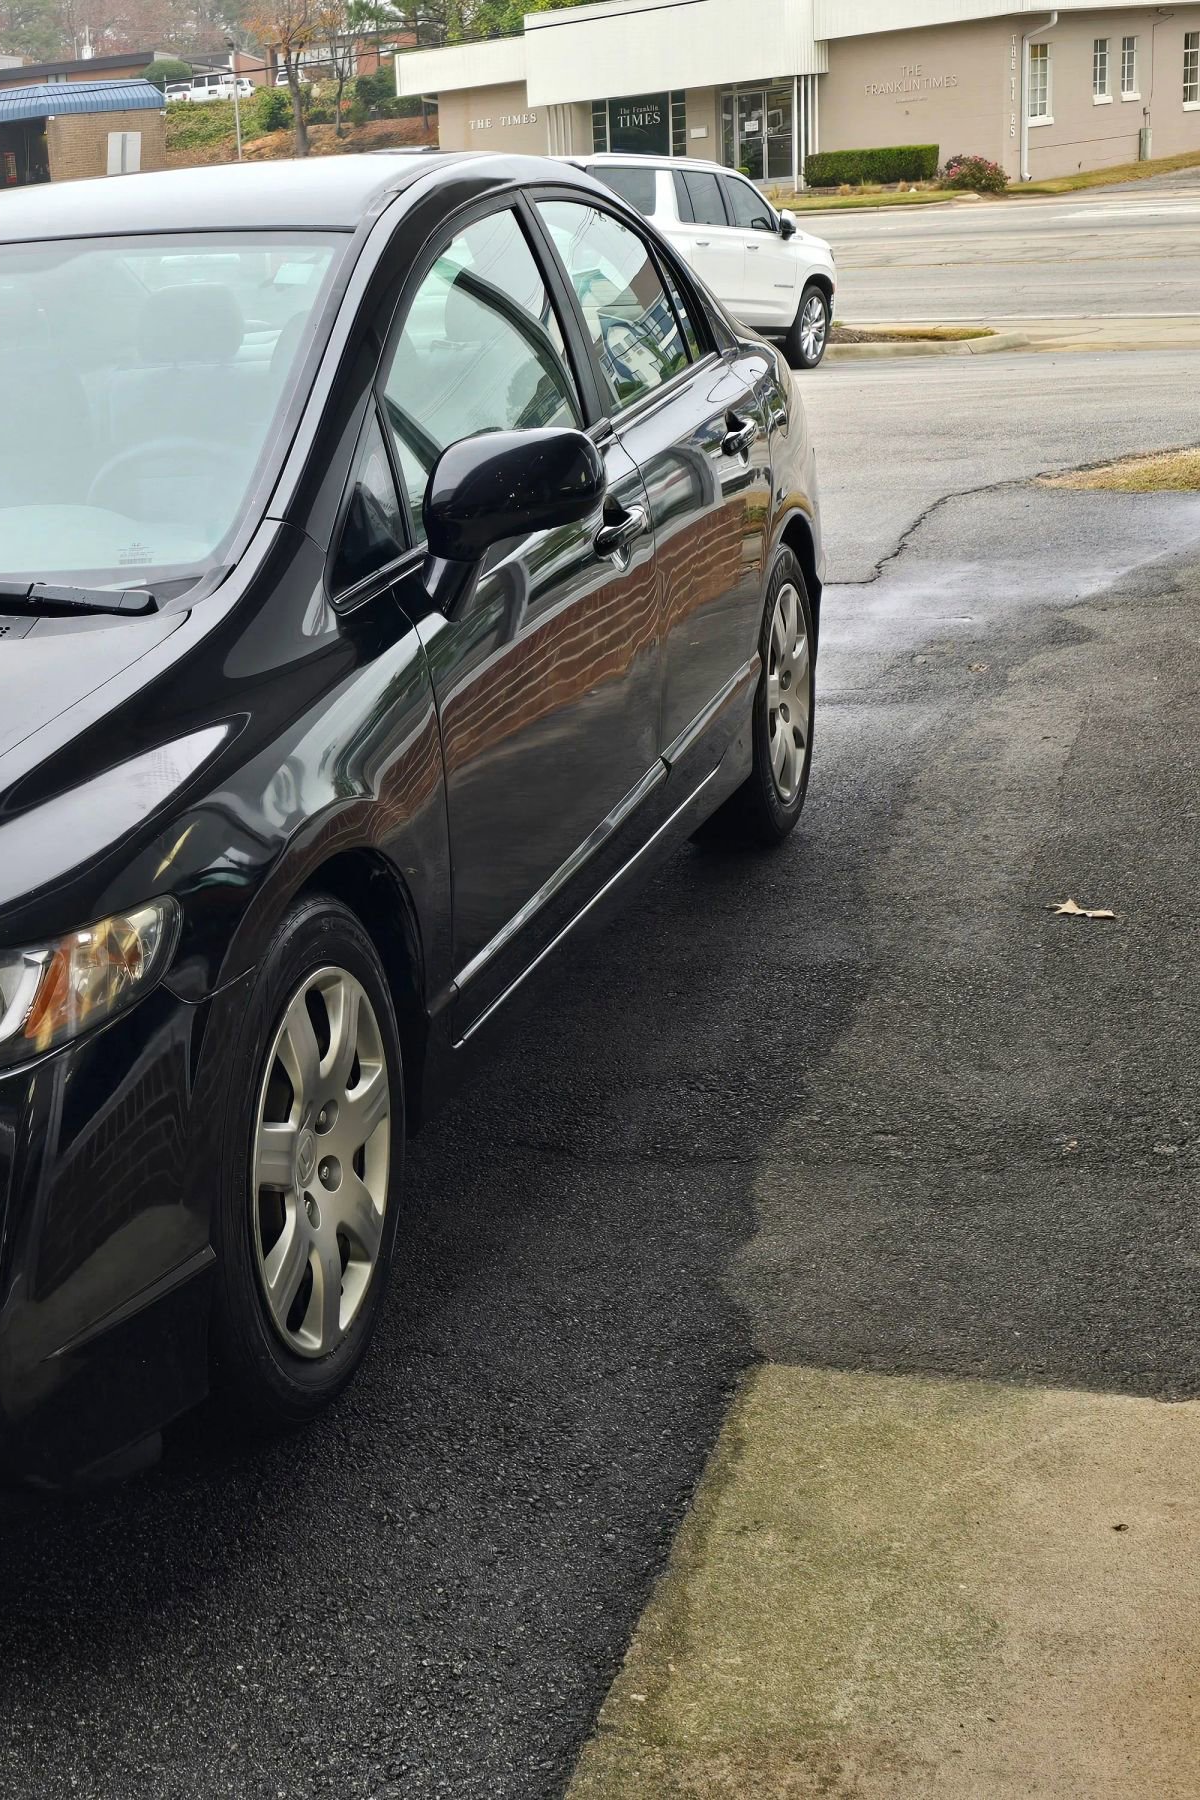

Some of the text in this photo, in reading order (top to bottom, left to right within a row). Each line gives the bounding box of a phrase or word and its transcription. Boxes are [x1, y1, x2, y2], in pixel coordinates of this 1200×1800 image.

[901, 64, 922, 77] THE
[864, 74, 958, 96] FRANKLIN TIMES
[619, 104, 659, 115] The Franklin
[469, 112, 538, 130] THE TIMES
[617, 111, 661, 128] TIMES
